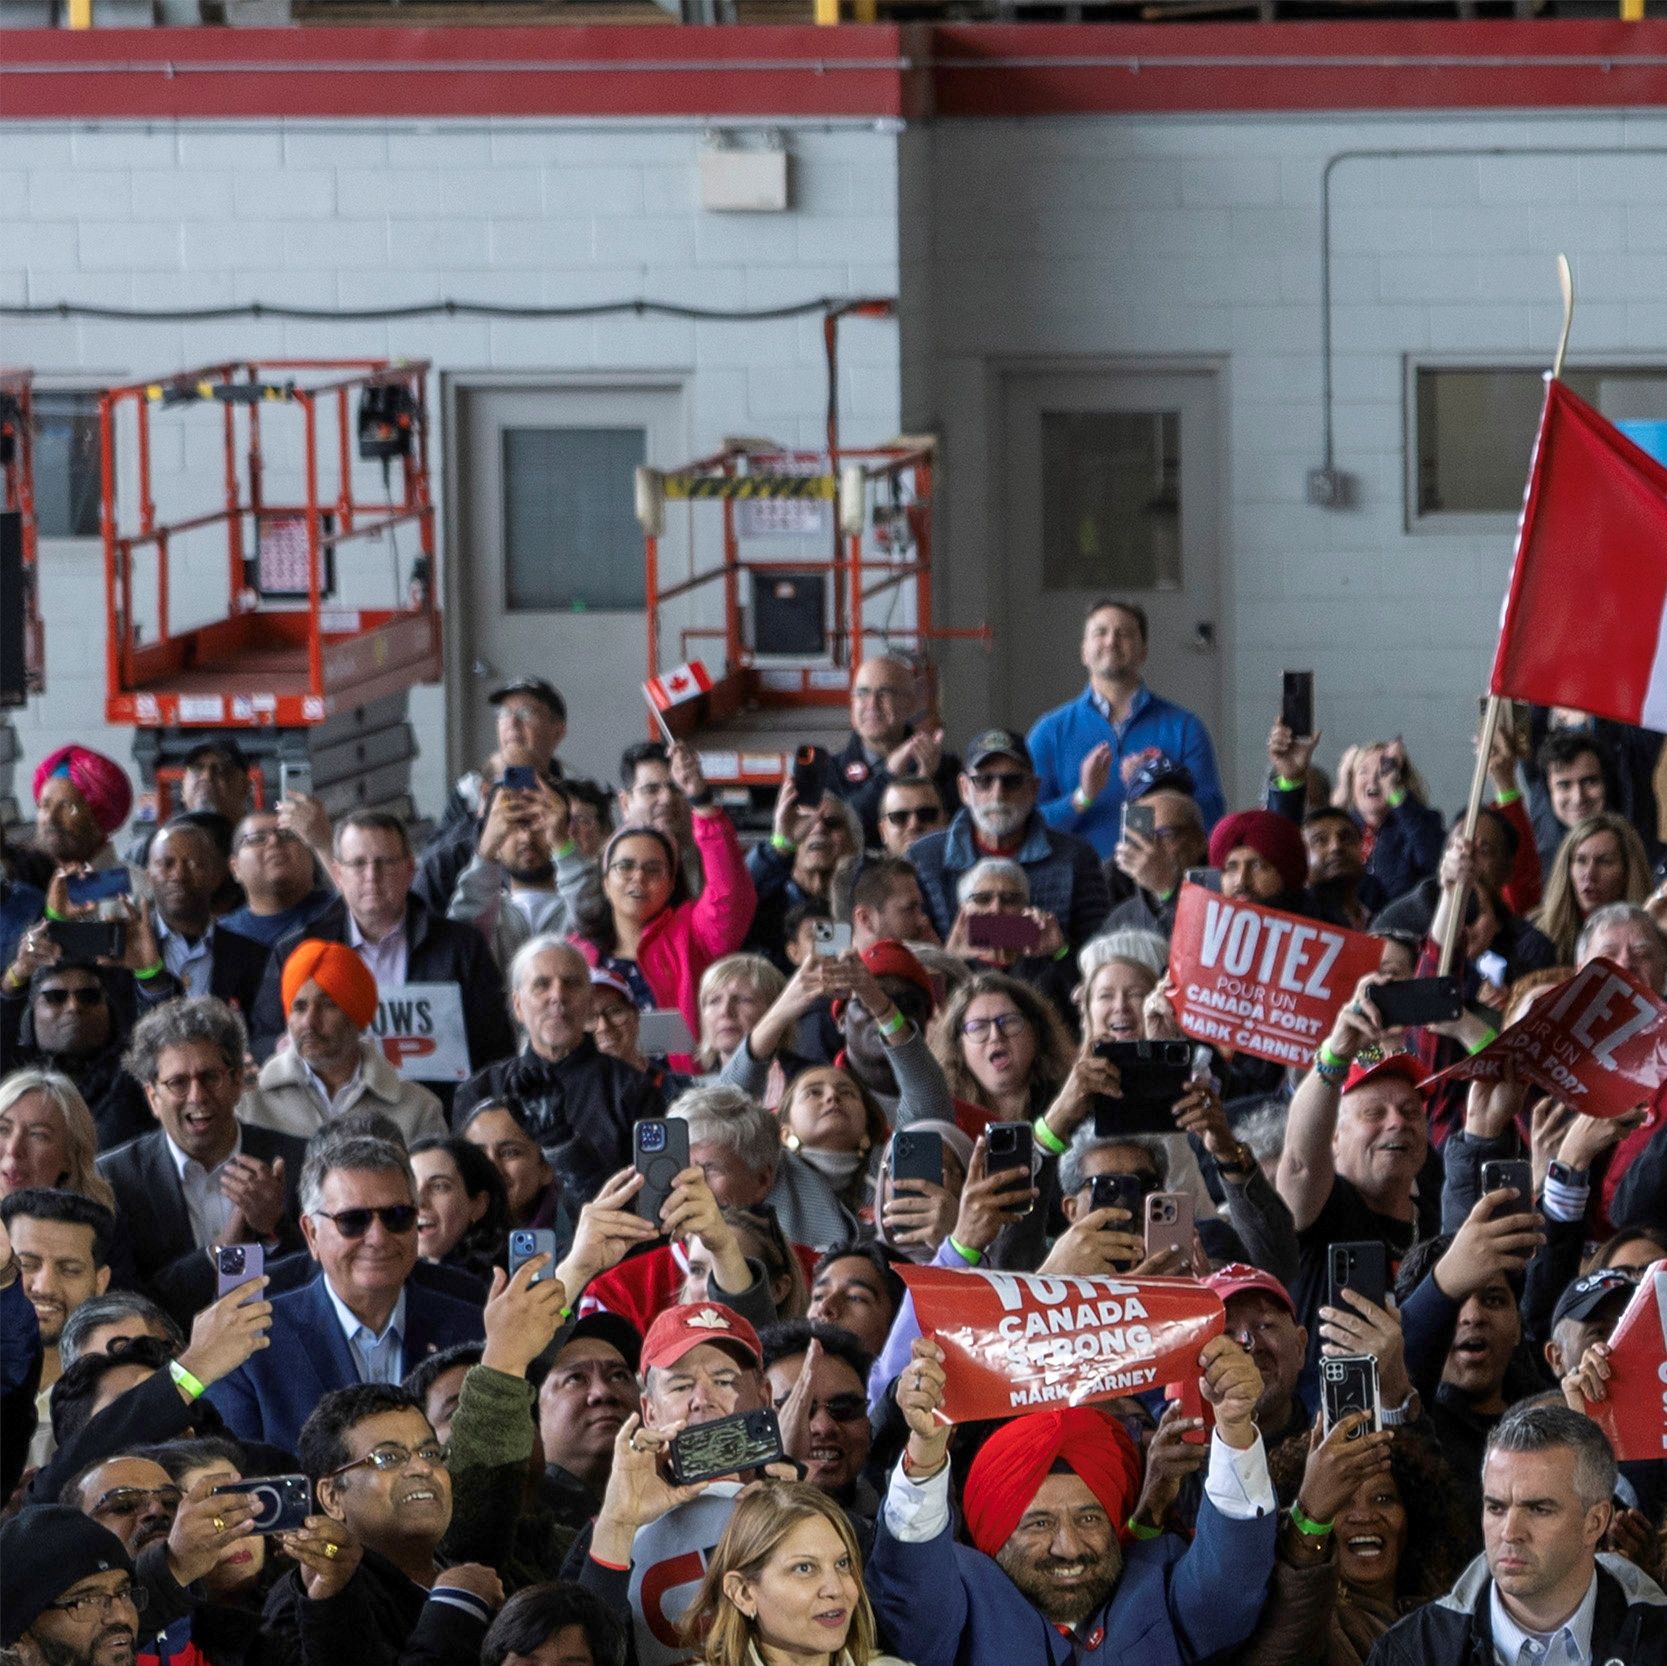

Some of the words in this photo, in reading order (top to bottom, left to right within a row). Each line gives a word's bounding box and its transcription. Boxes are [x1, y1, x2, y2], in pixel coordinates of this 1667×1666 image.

[1201, 900, 1345, 1000] VOTEZ
[1186, 983, 1265, 1022] CANADA
[1269, 1008, 1323, 1036] FORT
[1216, 975, 1265, 1001] POUR
[1270, 991, 1297, 1011] UN
[381, 1036, 437, 1071] P
[1181, 1012, 1232, 1041] MARK
[1235, 1029, 1315, 1064] CARNEY
[1542, 1056, 1590, 1096] FORT
[1000, 1297, 1148, 1340] CANADA
[1006, 1324, 1152, 1369] STRONG
[1009, 1379, 1064, 1408] MARK
